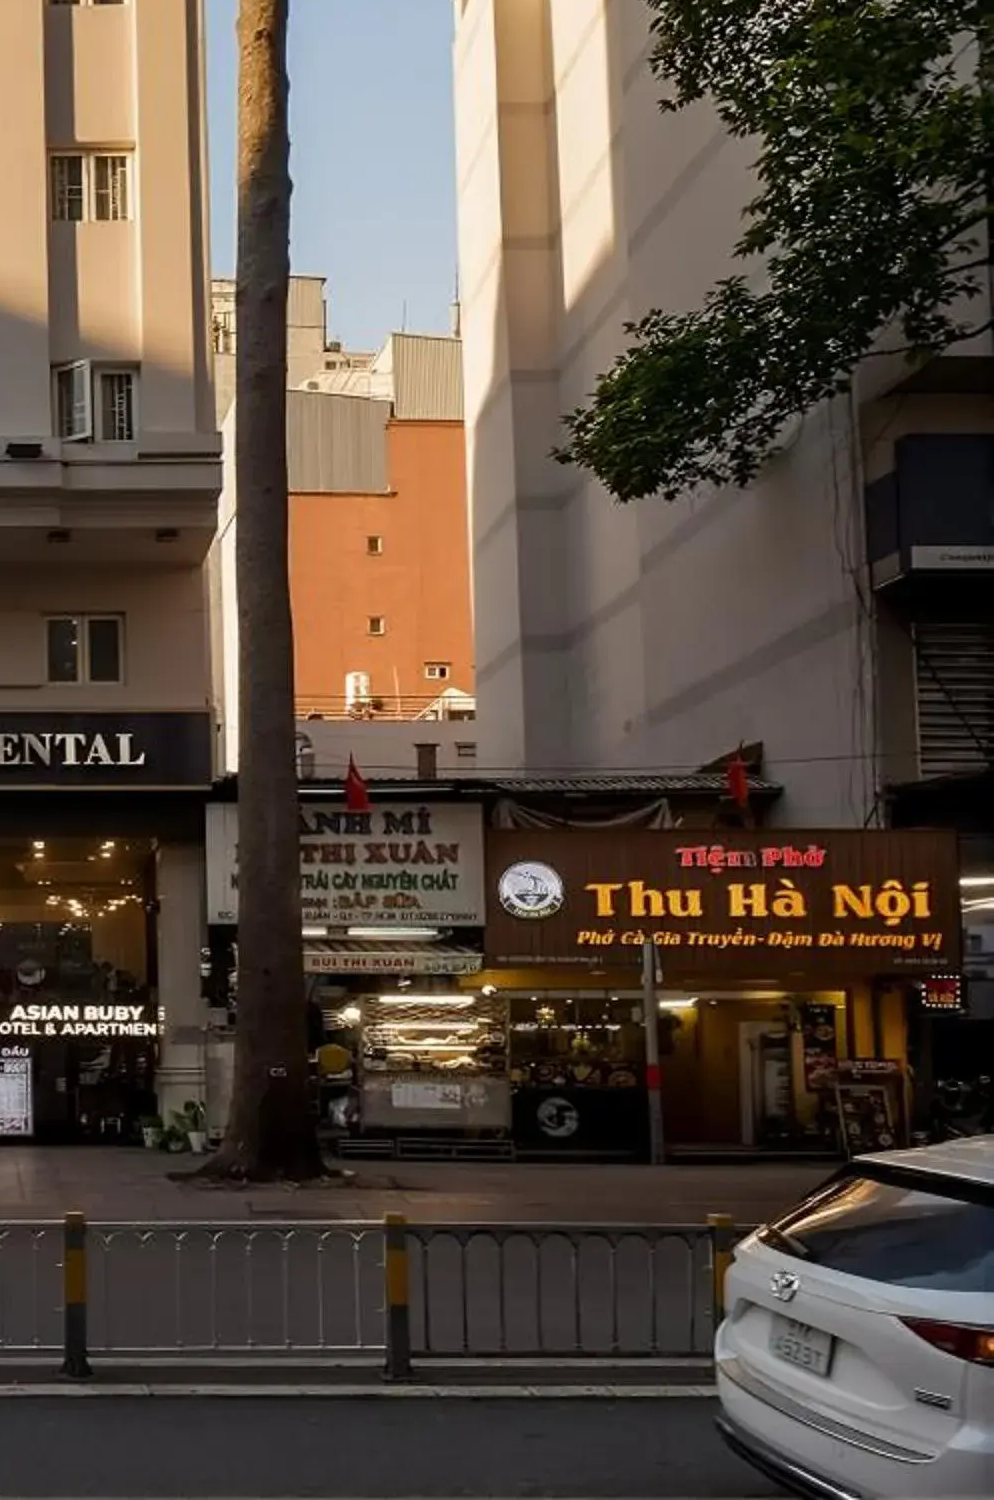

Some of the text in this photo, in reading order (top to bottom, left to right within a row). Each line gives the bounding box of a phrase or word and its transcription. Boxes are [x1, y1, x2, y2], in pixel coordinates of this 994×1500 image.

[675, 845, 826, 874] Tiệm Phở
[585, 879, 932, 926] Thu Hà Nội
[576, 929, 615, 946] Phở
[653, 931, 682, 945] Gia
[10, 1004, 79, 1021] ASIAN
[60, 1021, 158, 1037] APARTMEN
